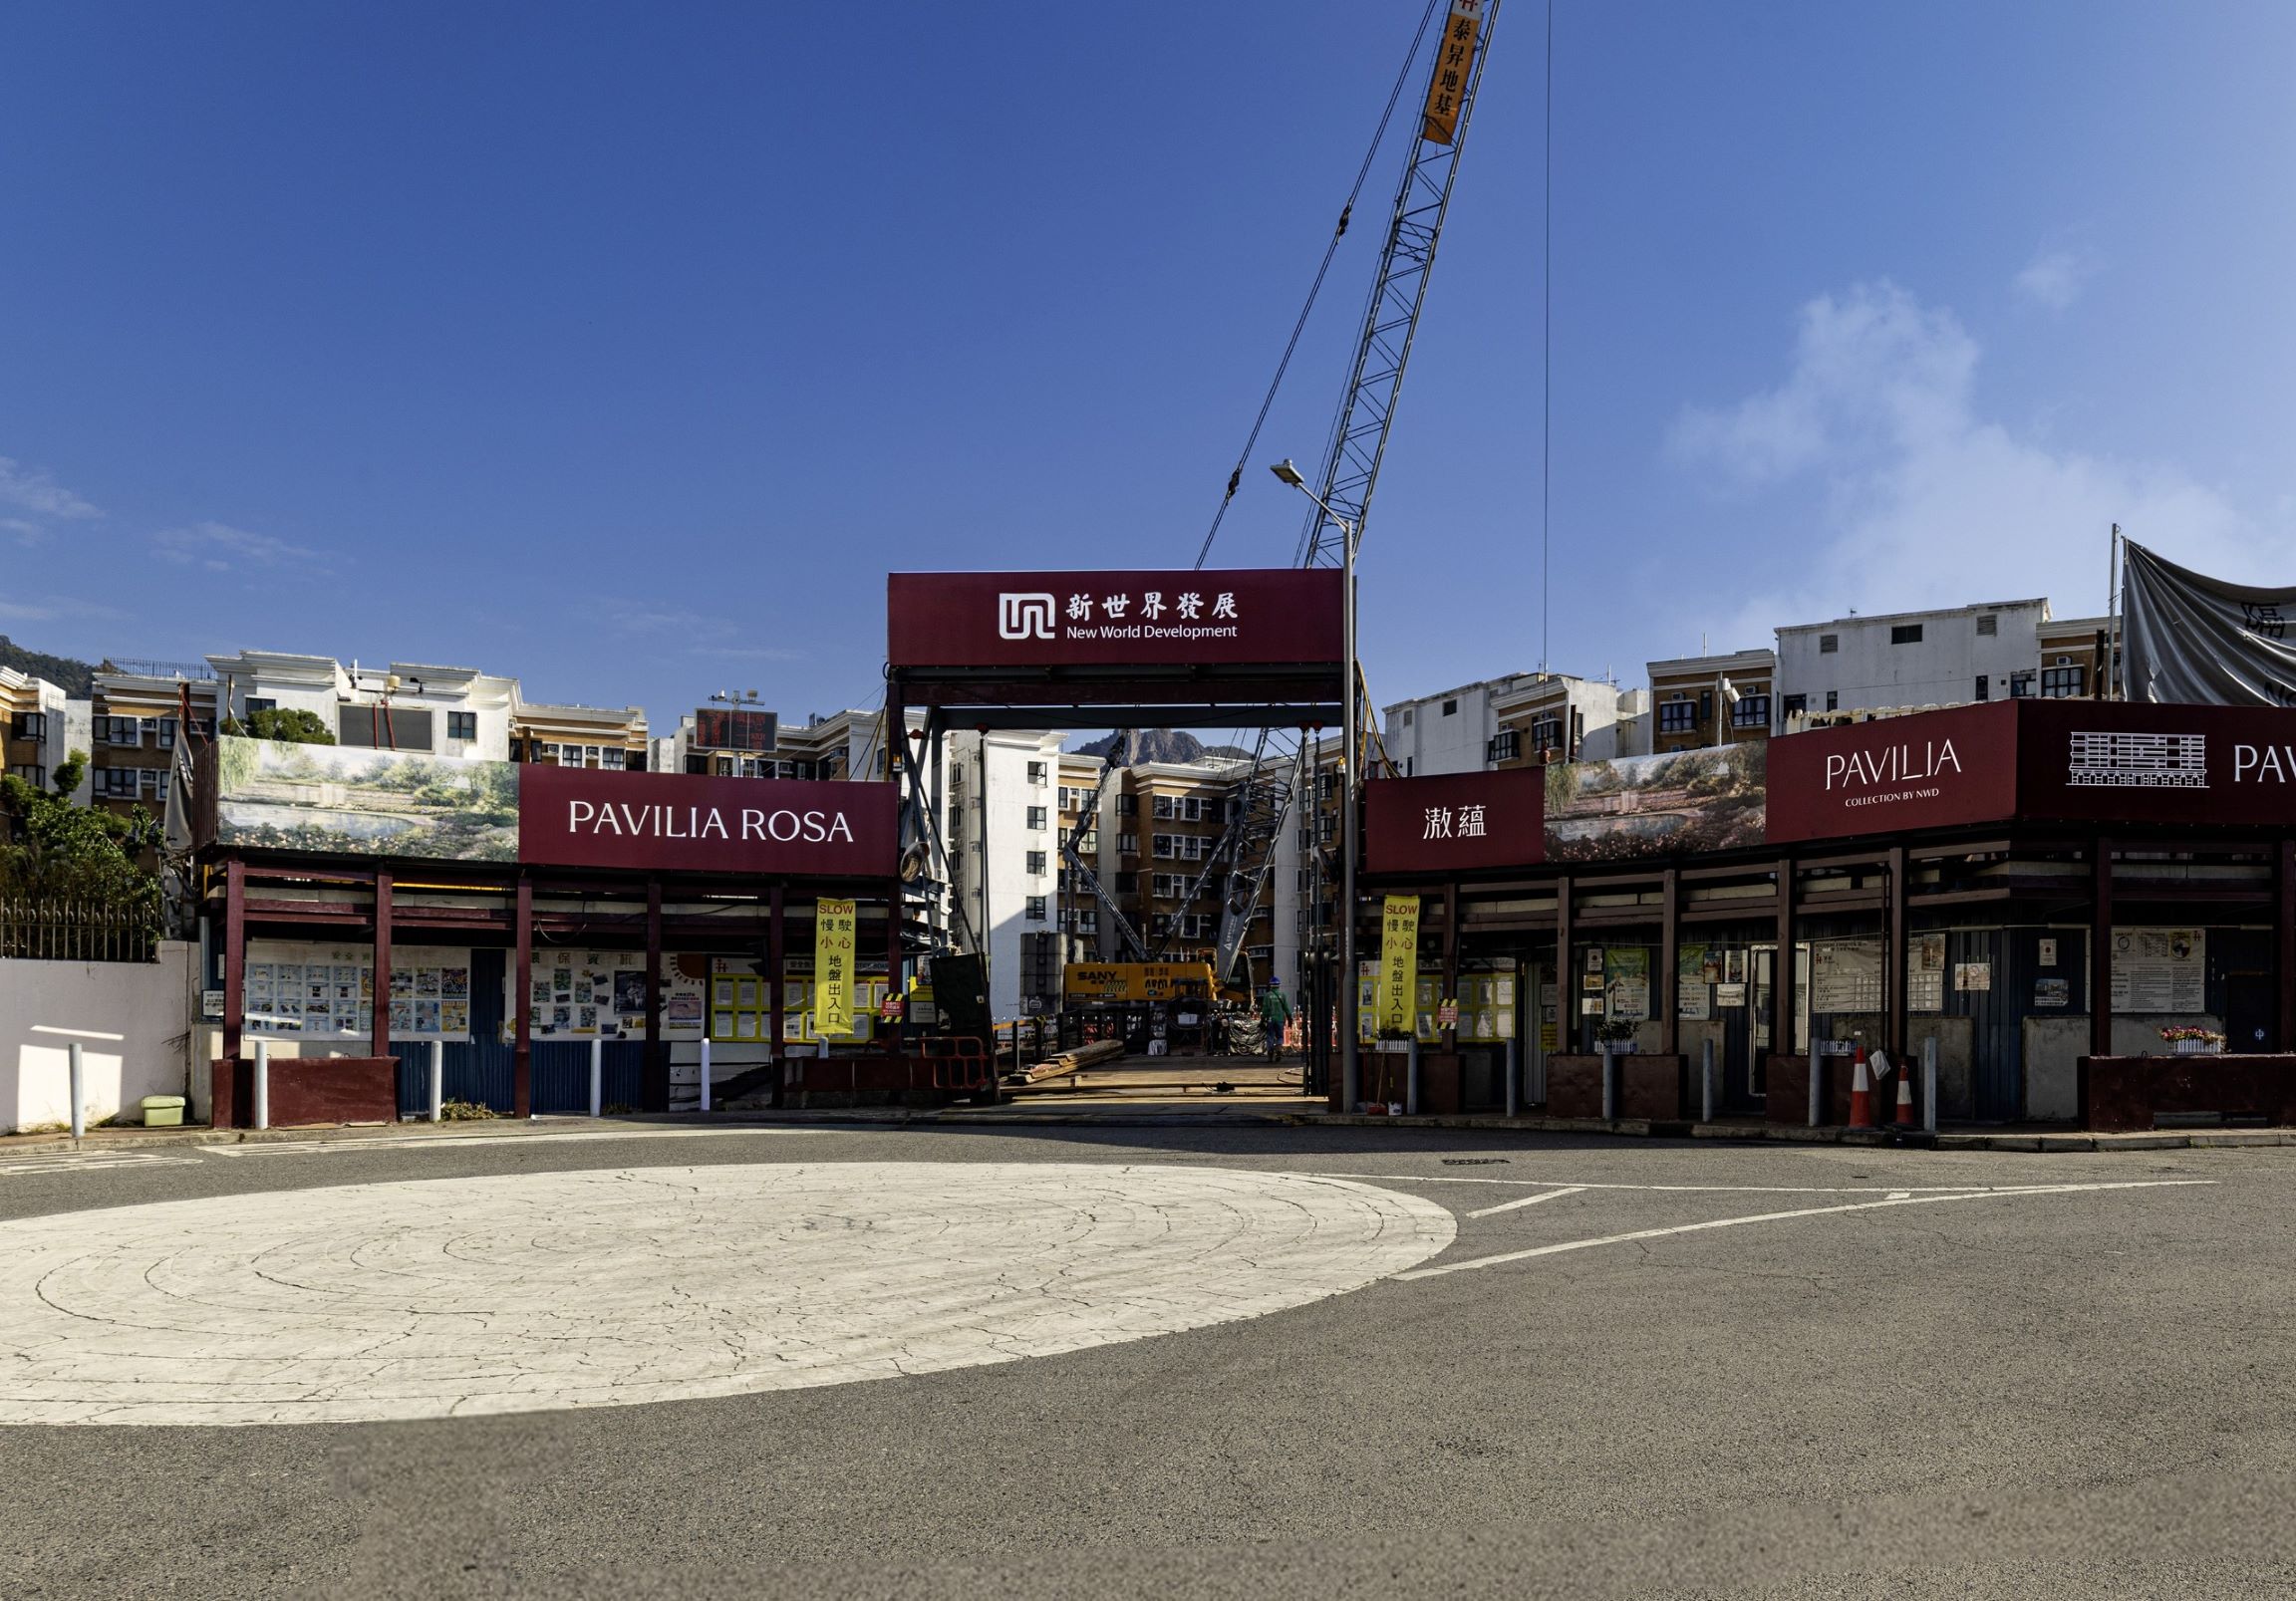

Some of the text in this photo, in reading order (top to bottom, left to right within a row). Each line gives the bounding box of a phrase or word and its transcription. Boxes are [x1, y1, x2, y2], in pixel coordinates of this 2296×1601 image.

[1435, 18, 1471, 117] 泰昇地基
[1065, 592, 1238, 622] 新世界發展
[1066, 625, 1238, 640] New World Development
[1826, 738, 1961, 790] PAVILIA
[1845, 787, 1939, 807] COLLECTION BY NWD
[569, 800, 854, 843] PAVILIA ROSA
[819, 904, 854, 916] SLOW
[1385, 904, 1418, 916] SLOW
[820, 919, 852, 932] 慢駛
[1386, 919, 1415, 933] 慢駛
[820, 935, 852, 949] 小心
[1385, 936, 1413, 950] 小心
[1077, 971, 1117, 981] SANY
[828, 954, 842, 1024] 地盤出入口
[1391, 955, 1404, 1025] 地盤出入口
